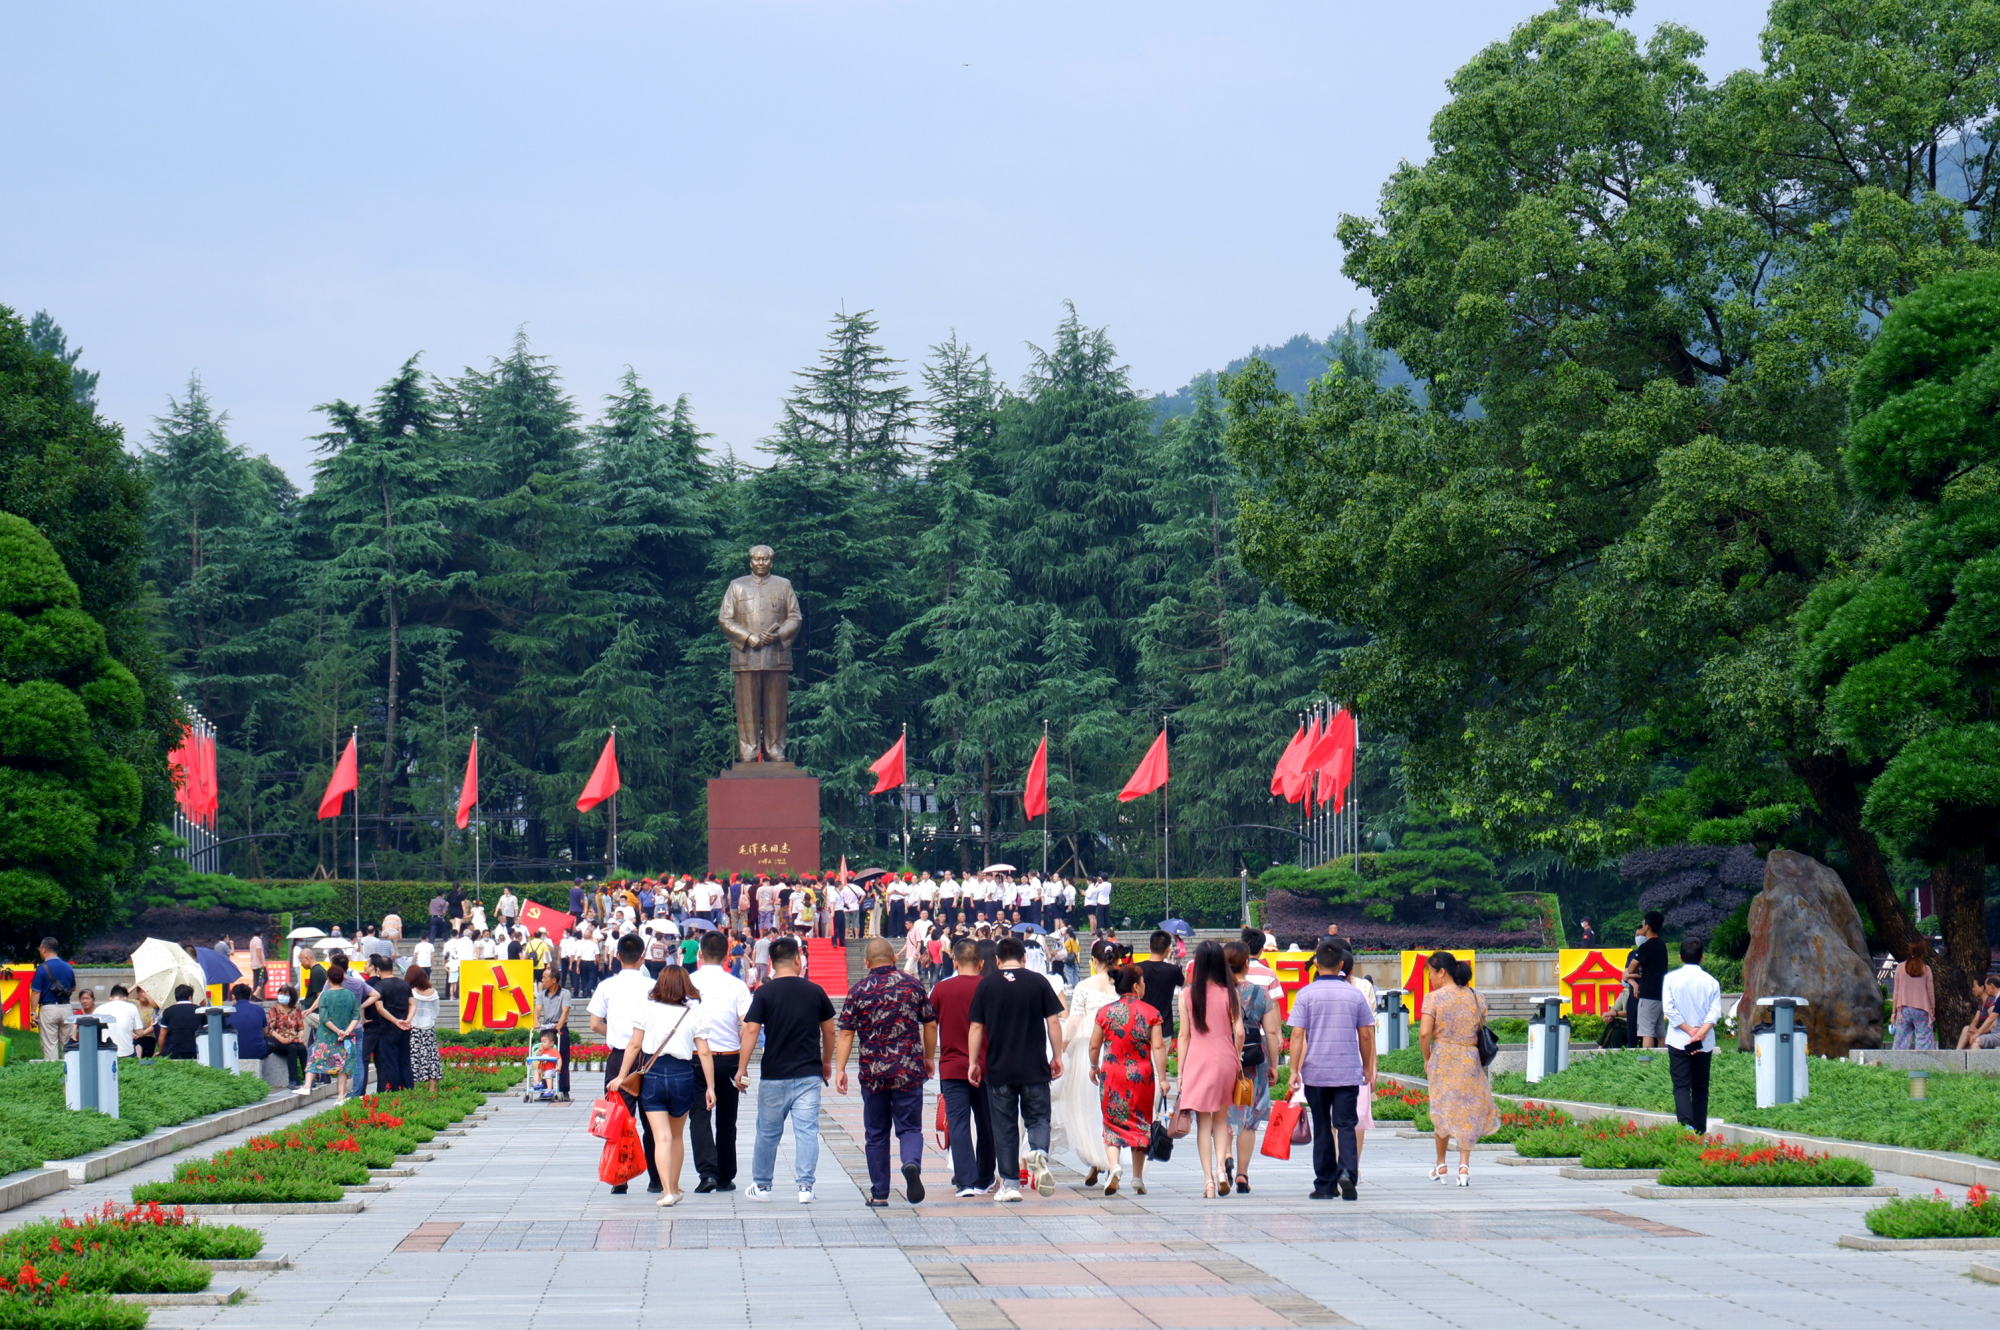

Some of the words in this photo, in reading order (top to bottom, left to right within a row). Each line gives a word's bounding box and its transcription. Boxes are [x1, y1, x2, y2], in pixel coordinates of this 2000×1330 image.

[739, 842, 791, 856] 毛泽东同志
[462, 965, 531, 1029] 心
[1562, 951, 1624, 1016] 命
